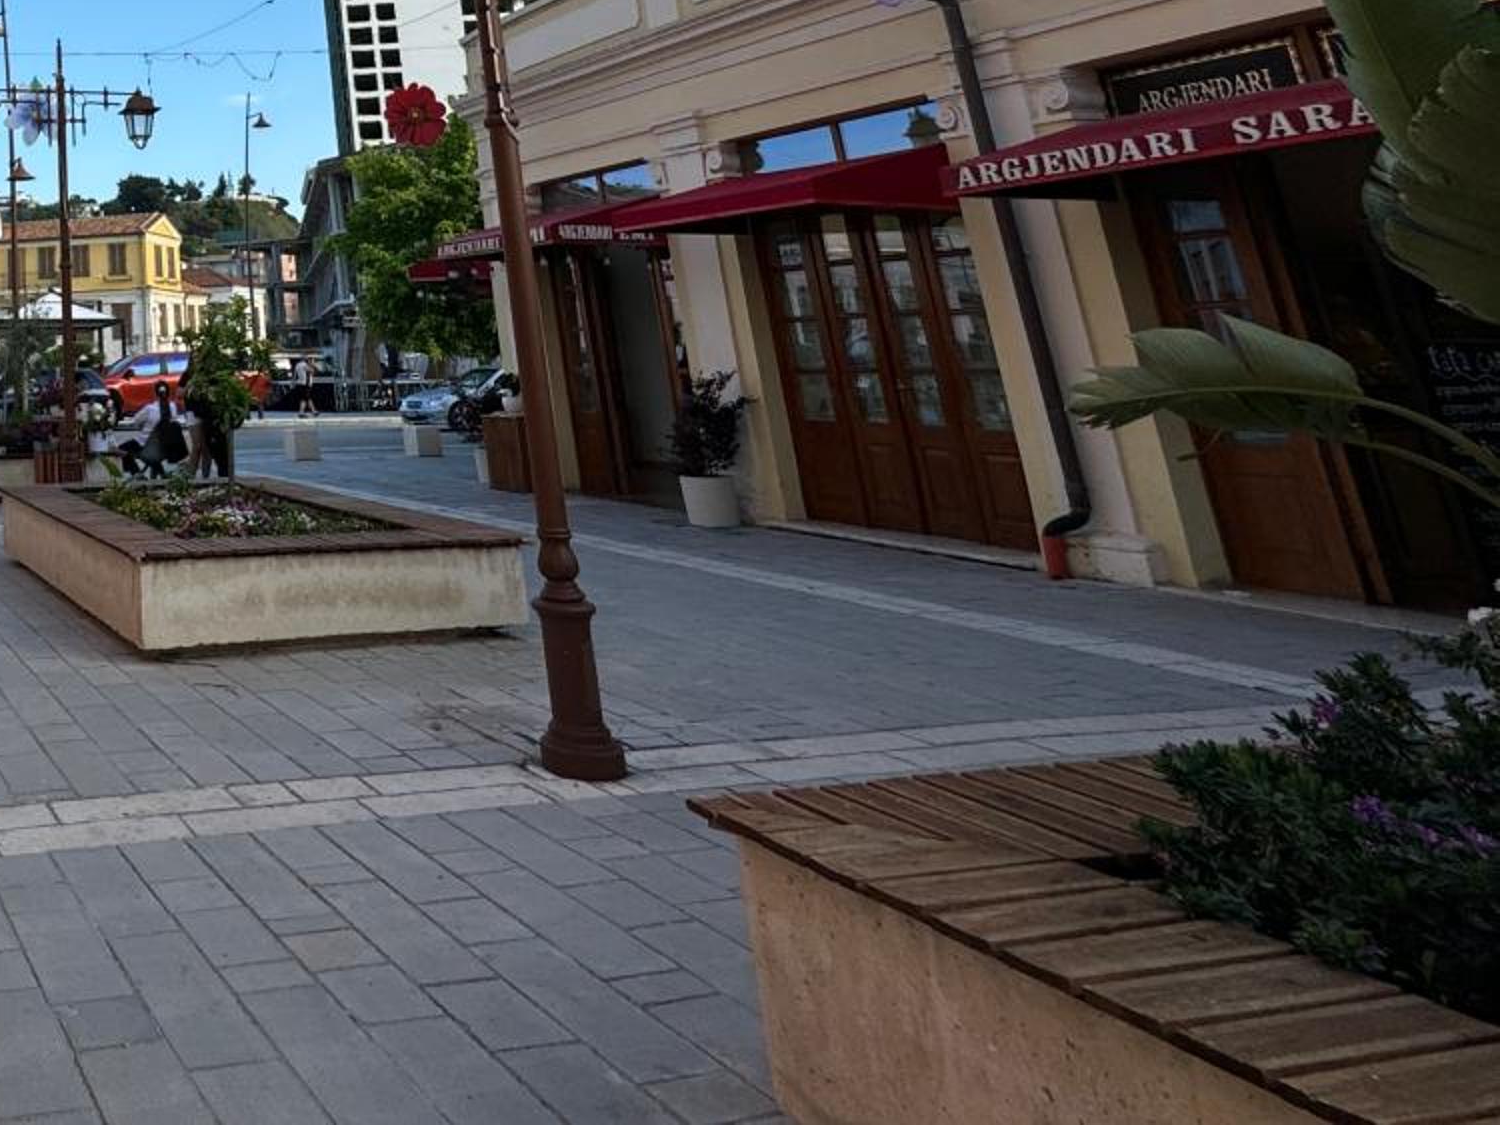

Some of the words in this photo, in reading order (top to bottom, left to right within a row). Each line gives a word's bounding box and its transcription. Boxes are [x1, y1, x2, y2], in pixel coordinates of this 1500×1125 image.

[1138, 68, 1274, 113] ARGJENDARI
[957, 127, 1198, 190] ARGJENDARI
[1232, 98, 1377, 145] SARA
